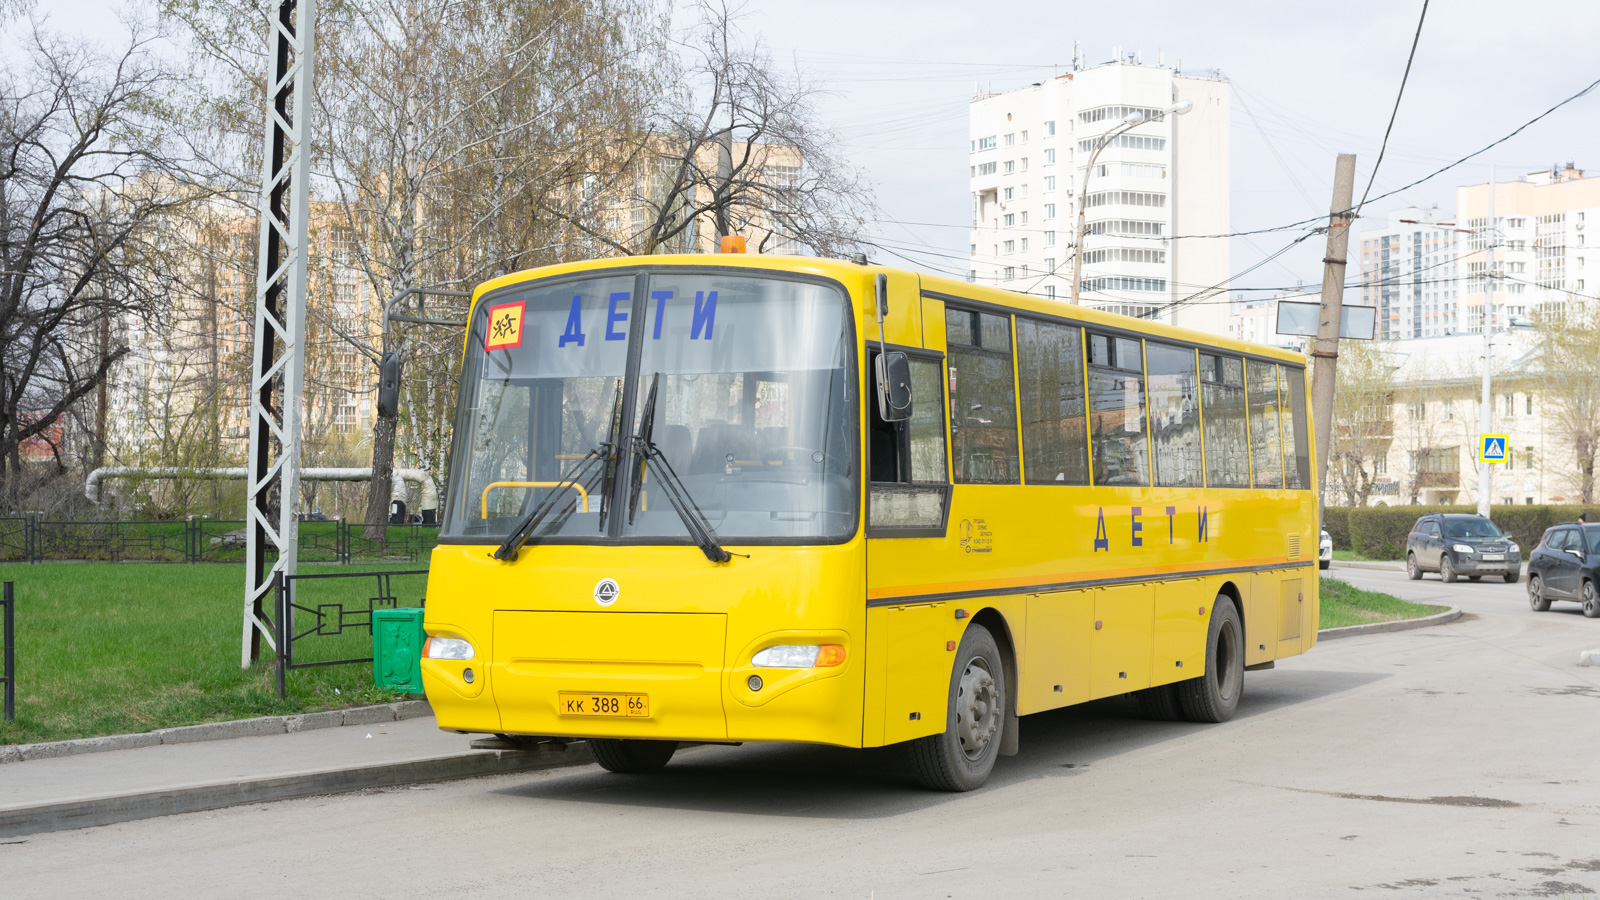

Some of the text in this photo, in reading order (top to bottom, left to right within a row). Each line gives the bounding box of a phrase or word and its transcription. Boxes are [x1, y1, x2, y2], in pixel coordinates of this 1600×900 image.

[558, 290, 719, 348] ДЕТИ
[1094, 505, 1208, 552] ДЕТИ
[592, 697, 619, 713] 388
[628, 697, 643, 709] 66
